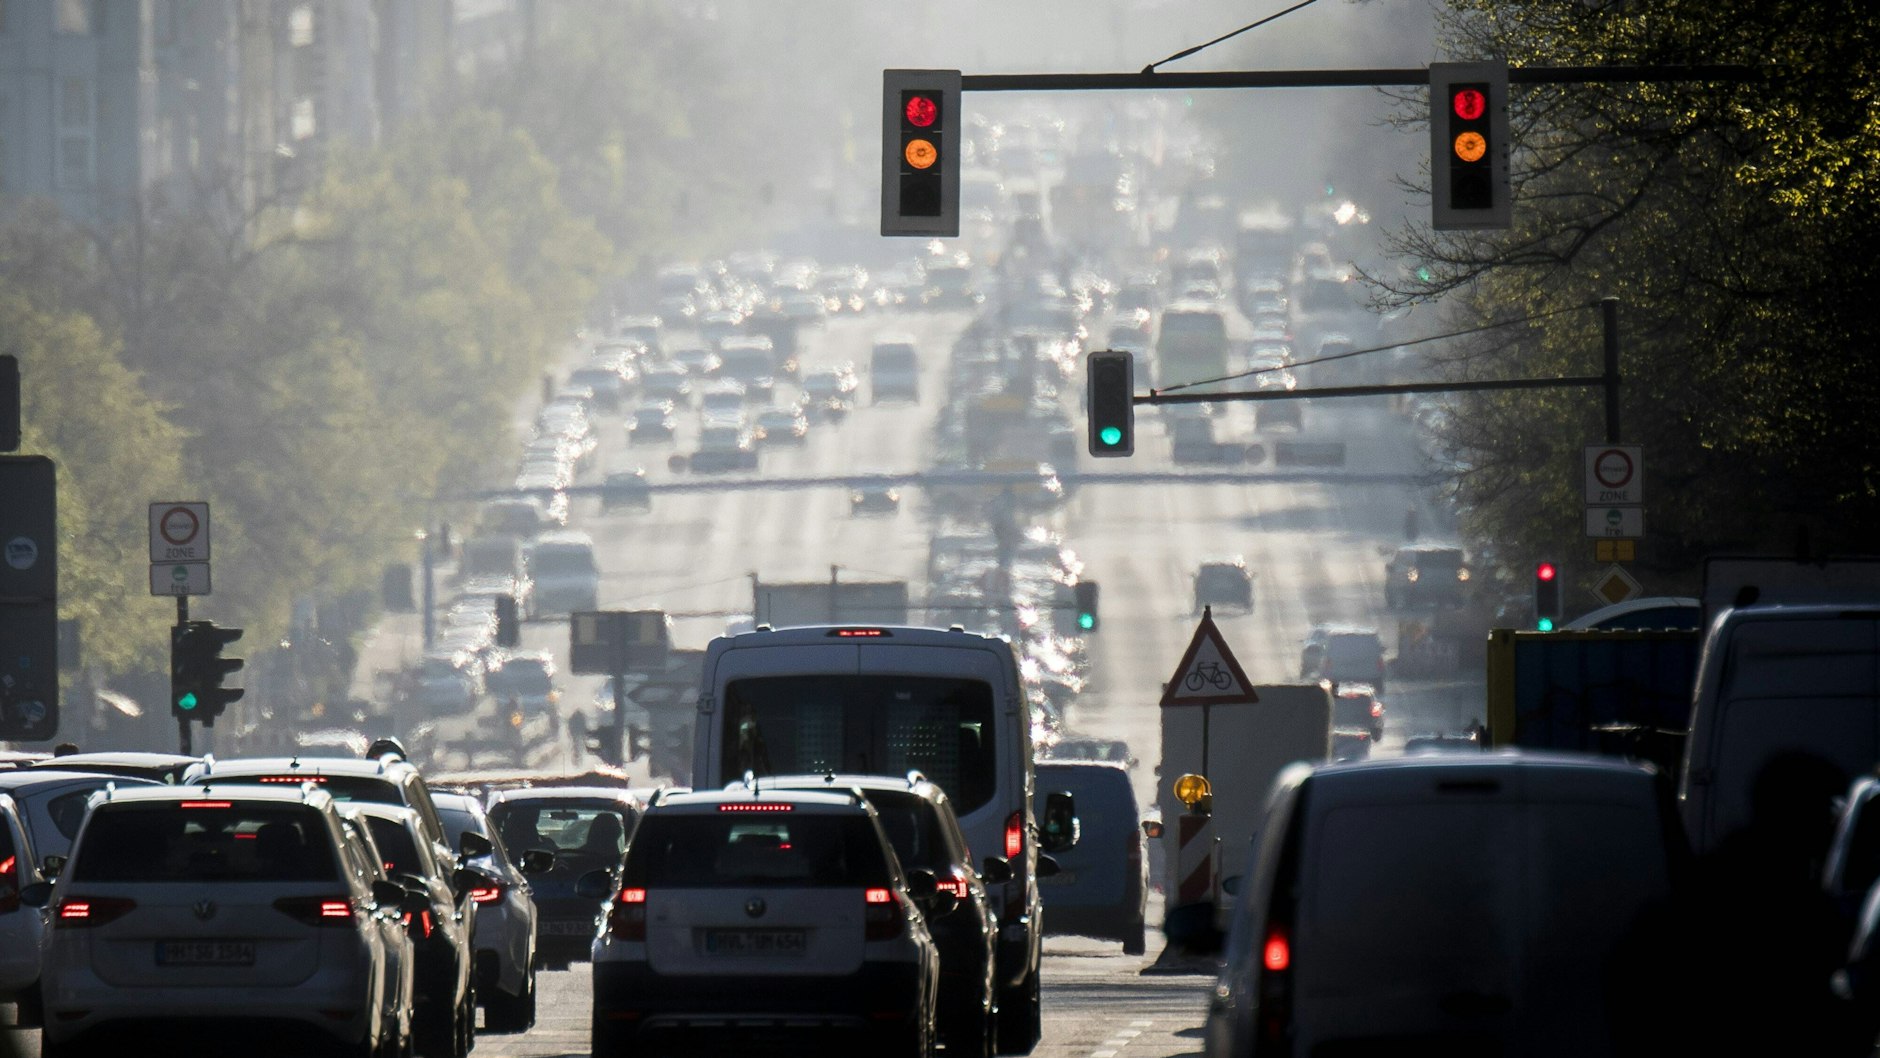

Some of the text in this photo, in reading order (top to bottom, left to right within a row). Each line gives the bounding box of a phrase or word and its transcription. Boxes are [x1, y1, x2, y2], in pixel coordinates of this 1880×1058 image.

[1600, 491, 1628, 501] ZONE
[1605, 526, 1624, 536] frei
[166, 547, 195, 558] ZONE
[171, 583, 190, 593] frei
